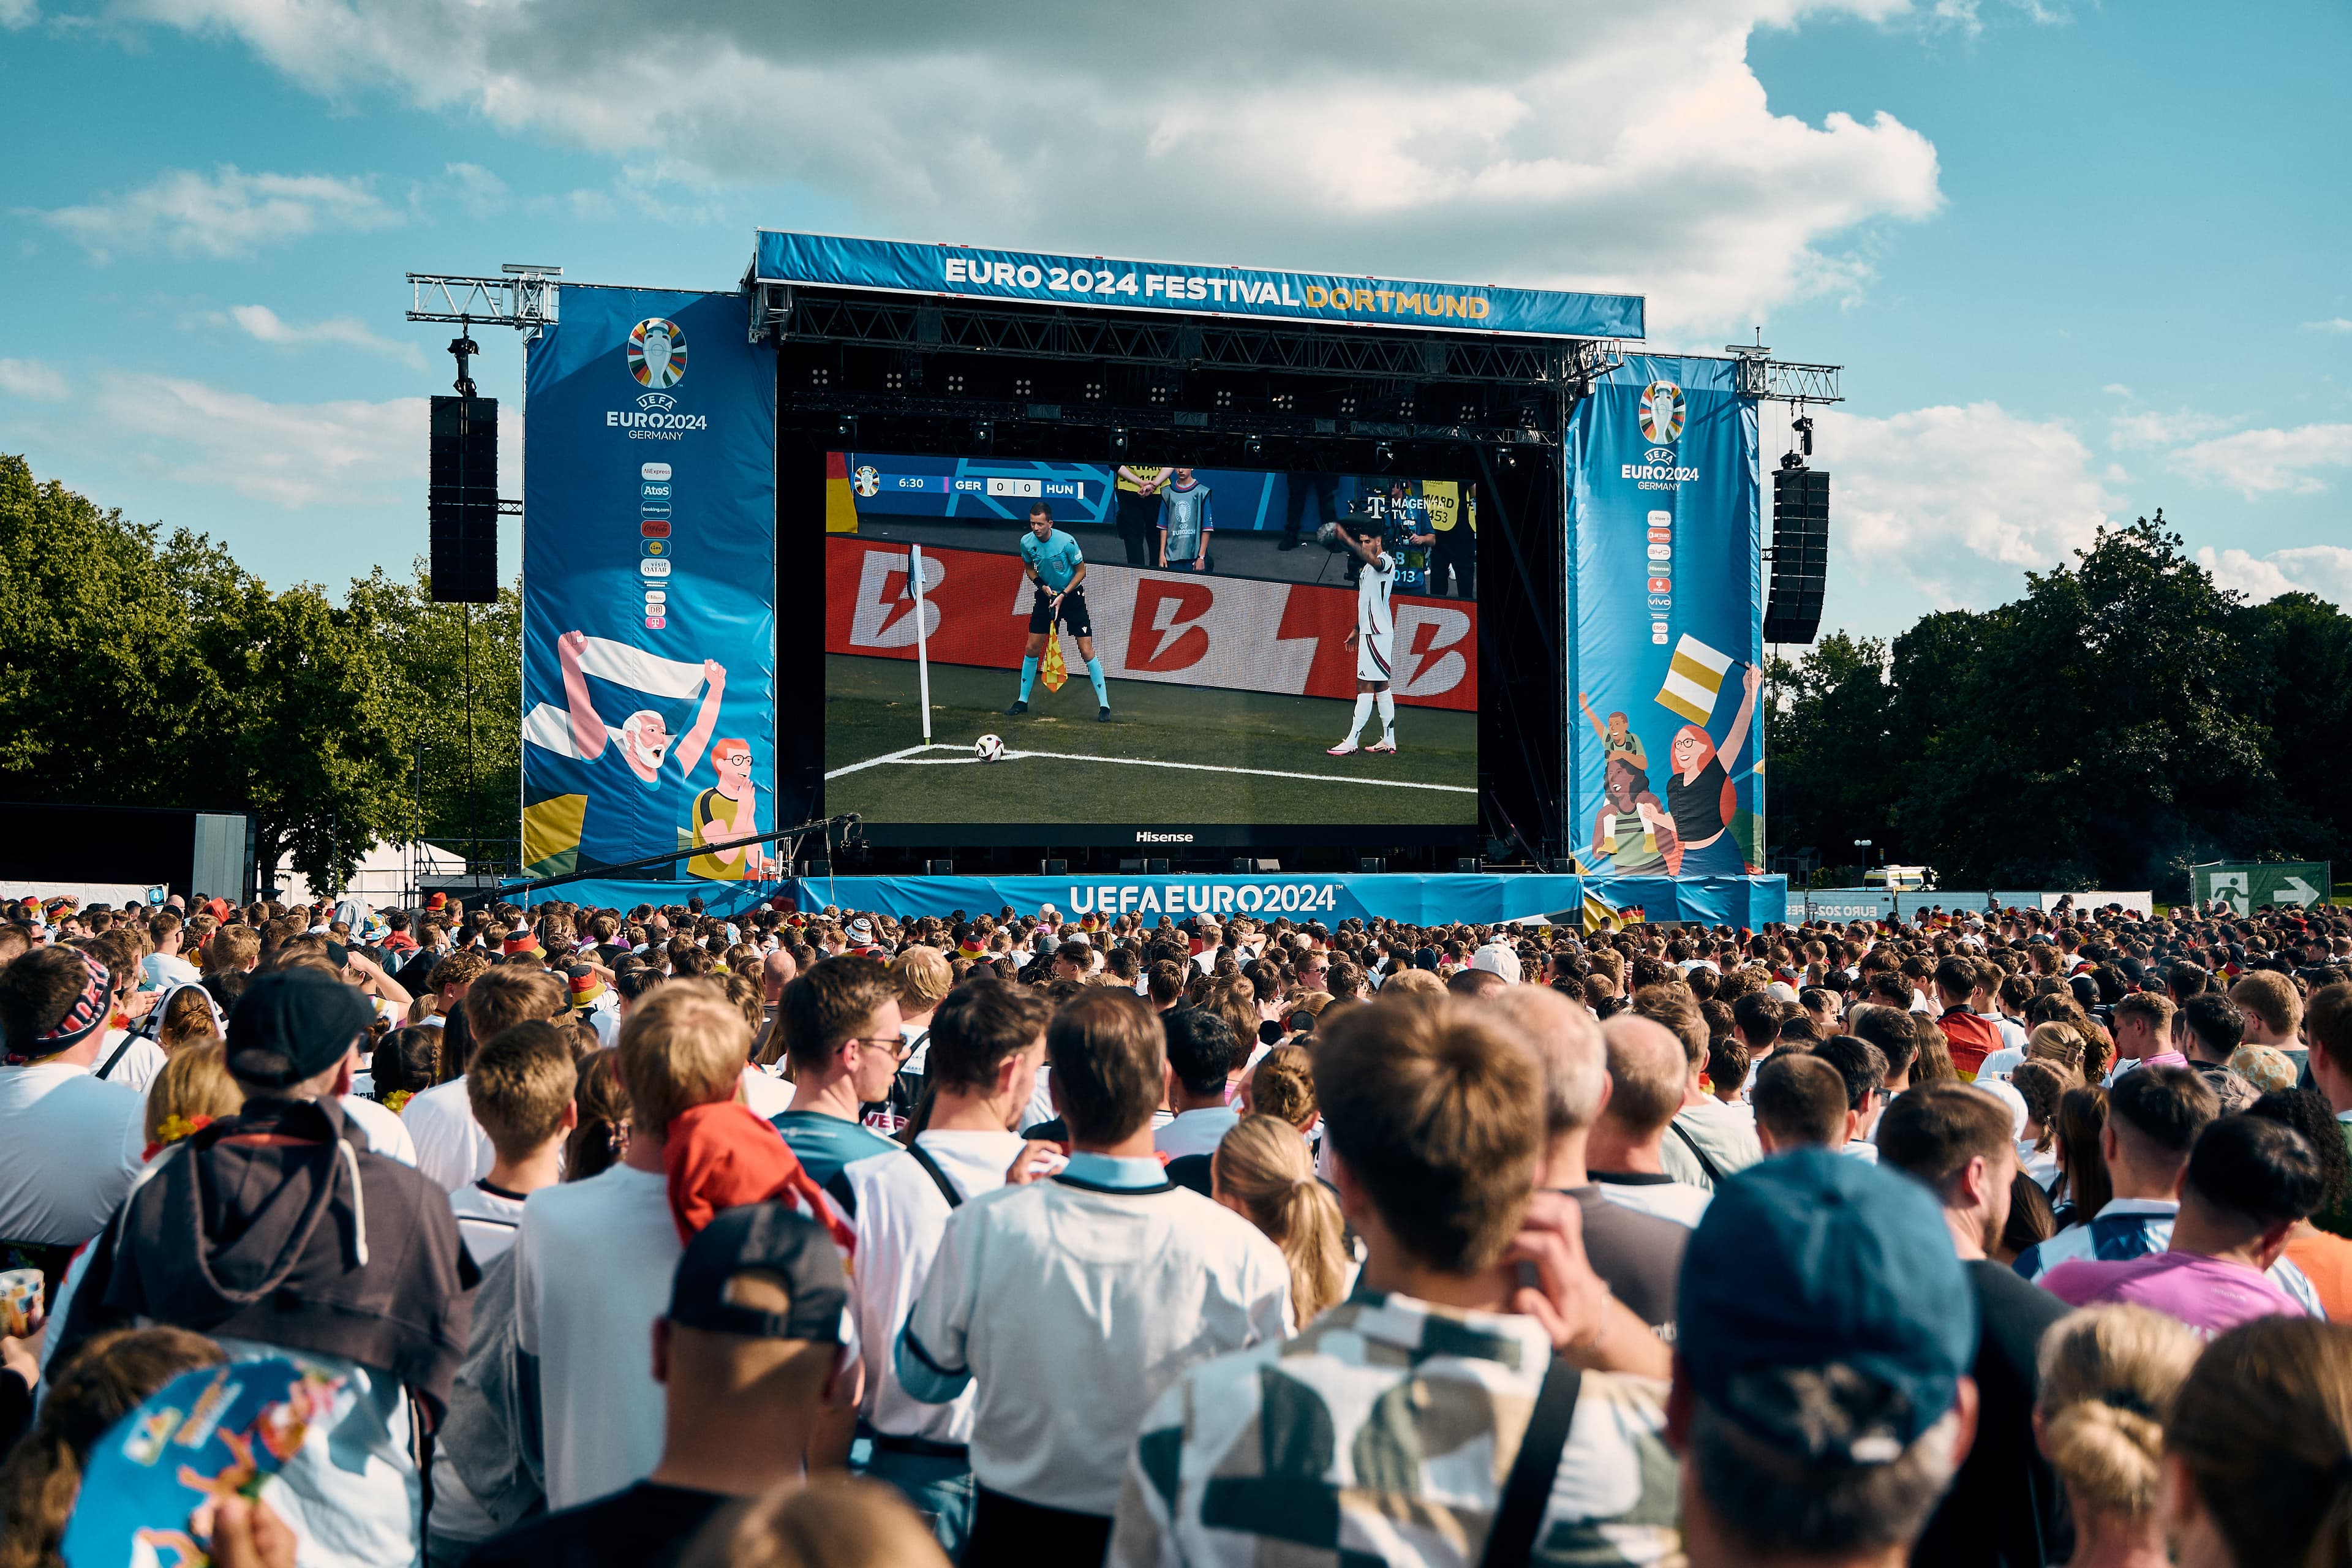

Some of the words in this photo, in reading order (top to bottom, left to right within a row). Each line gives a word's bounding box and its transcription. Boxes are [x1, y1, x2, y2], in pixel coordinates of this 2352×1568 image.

[945, 257, 1042, 289] EURO
[1048, 267, 1139, 297] 2024
[1146, 274, 1300, 307] FESTIVAL
[1306, 285, 1490, 320] DORTMUND
[638, 395, 673, 410] UEFA
[606, 411, 707, 430] EURO2024
[628, 430, 684, 440] GERMANY
[1646, 450, 1673, 463] UEFA
[1621, 464, 1699, 481] EURO2024
[899, 478, 924, 489] 6:30
[955, 480, 981, 491] GER
[997, 481, 1004, 492] 0
[1023, 483, 1031, 492] 0
[1047, 484, 1073, 495] HUN
[1638, 481, 1681, 491] GERMANY
[644, 486, 669, 495] Atos
[1392, 498, 1445, 510] MAGENTA
[1392, 510, 1407, 519] TV
[1136, 831, 1194, 843] Hisense
[153, 891, 160, 900] 4
